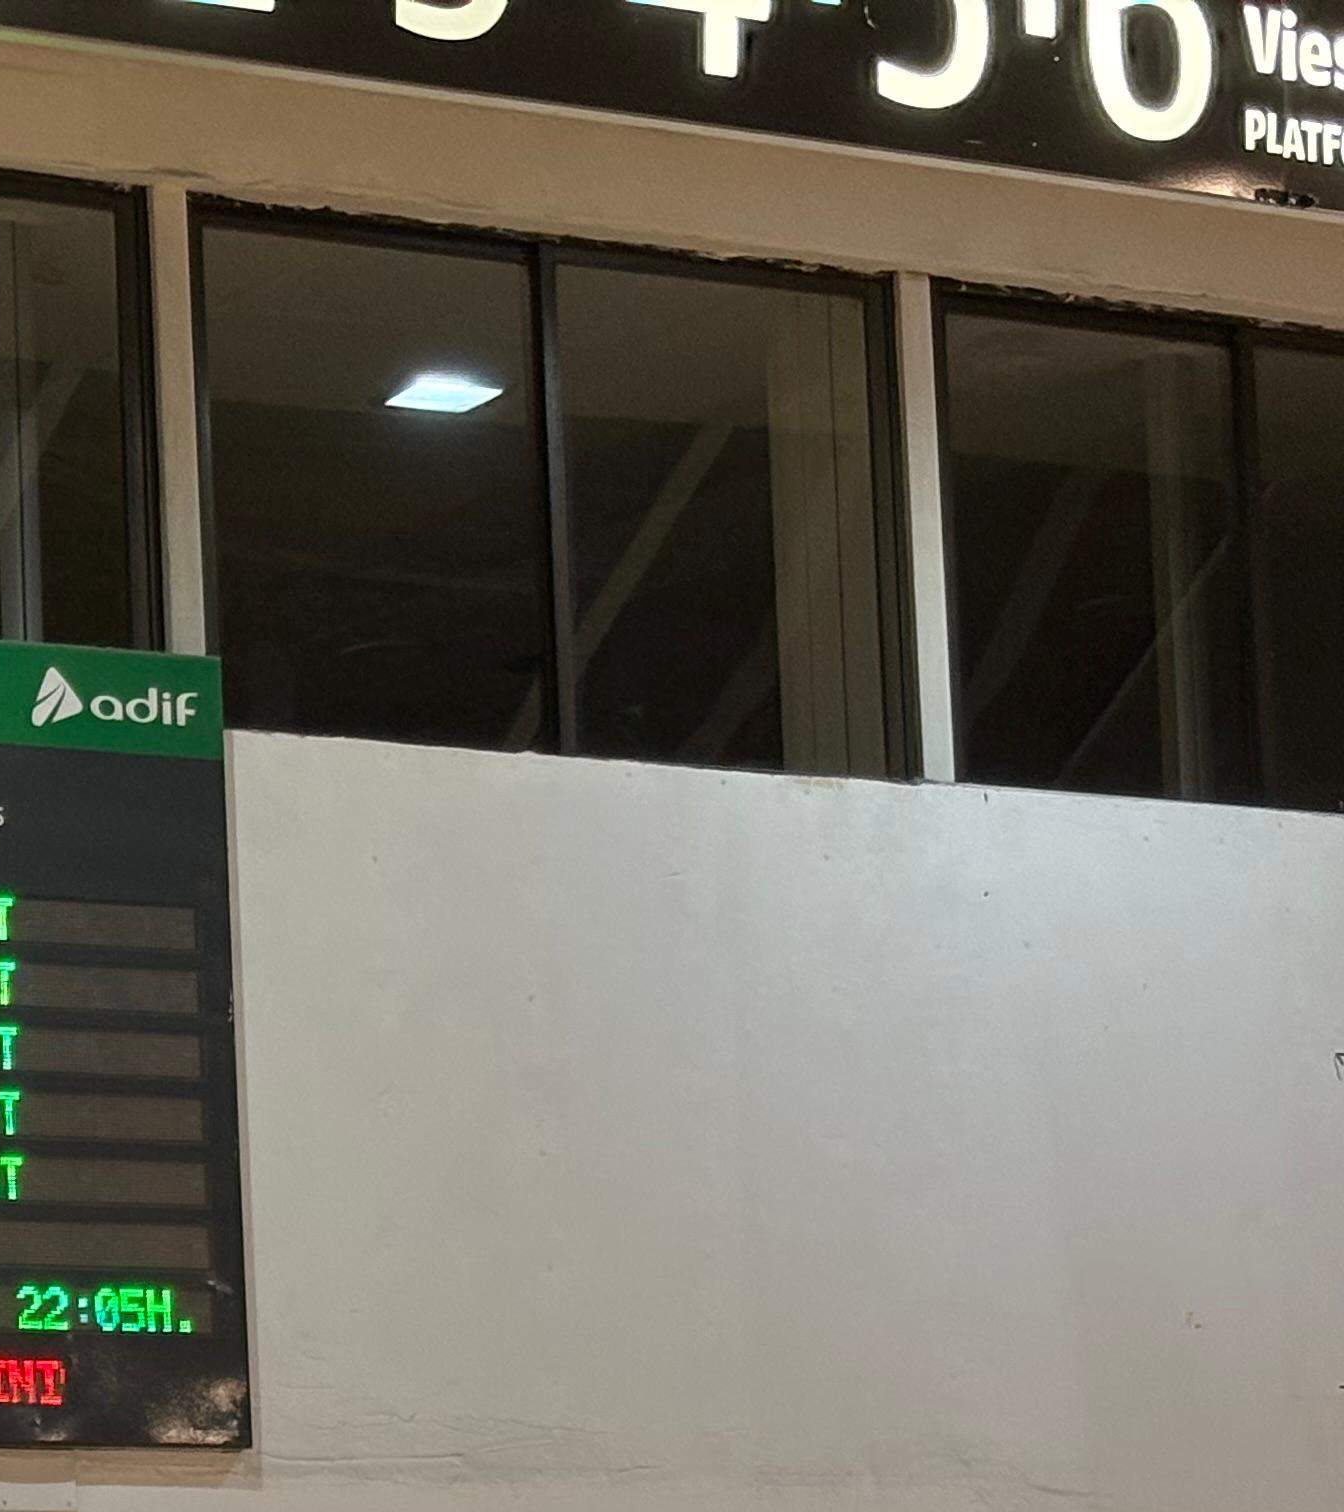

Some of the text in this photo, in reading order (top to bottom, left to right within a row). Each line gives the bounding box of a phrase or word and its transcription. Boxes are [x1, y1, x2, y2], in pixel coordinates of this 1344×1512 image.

[1245, 108, 1344, 165] PLATF
[91, 688, 197, 726] adif
[16, 1282, 192, 1333] 22:05H.
